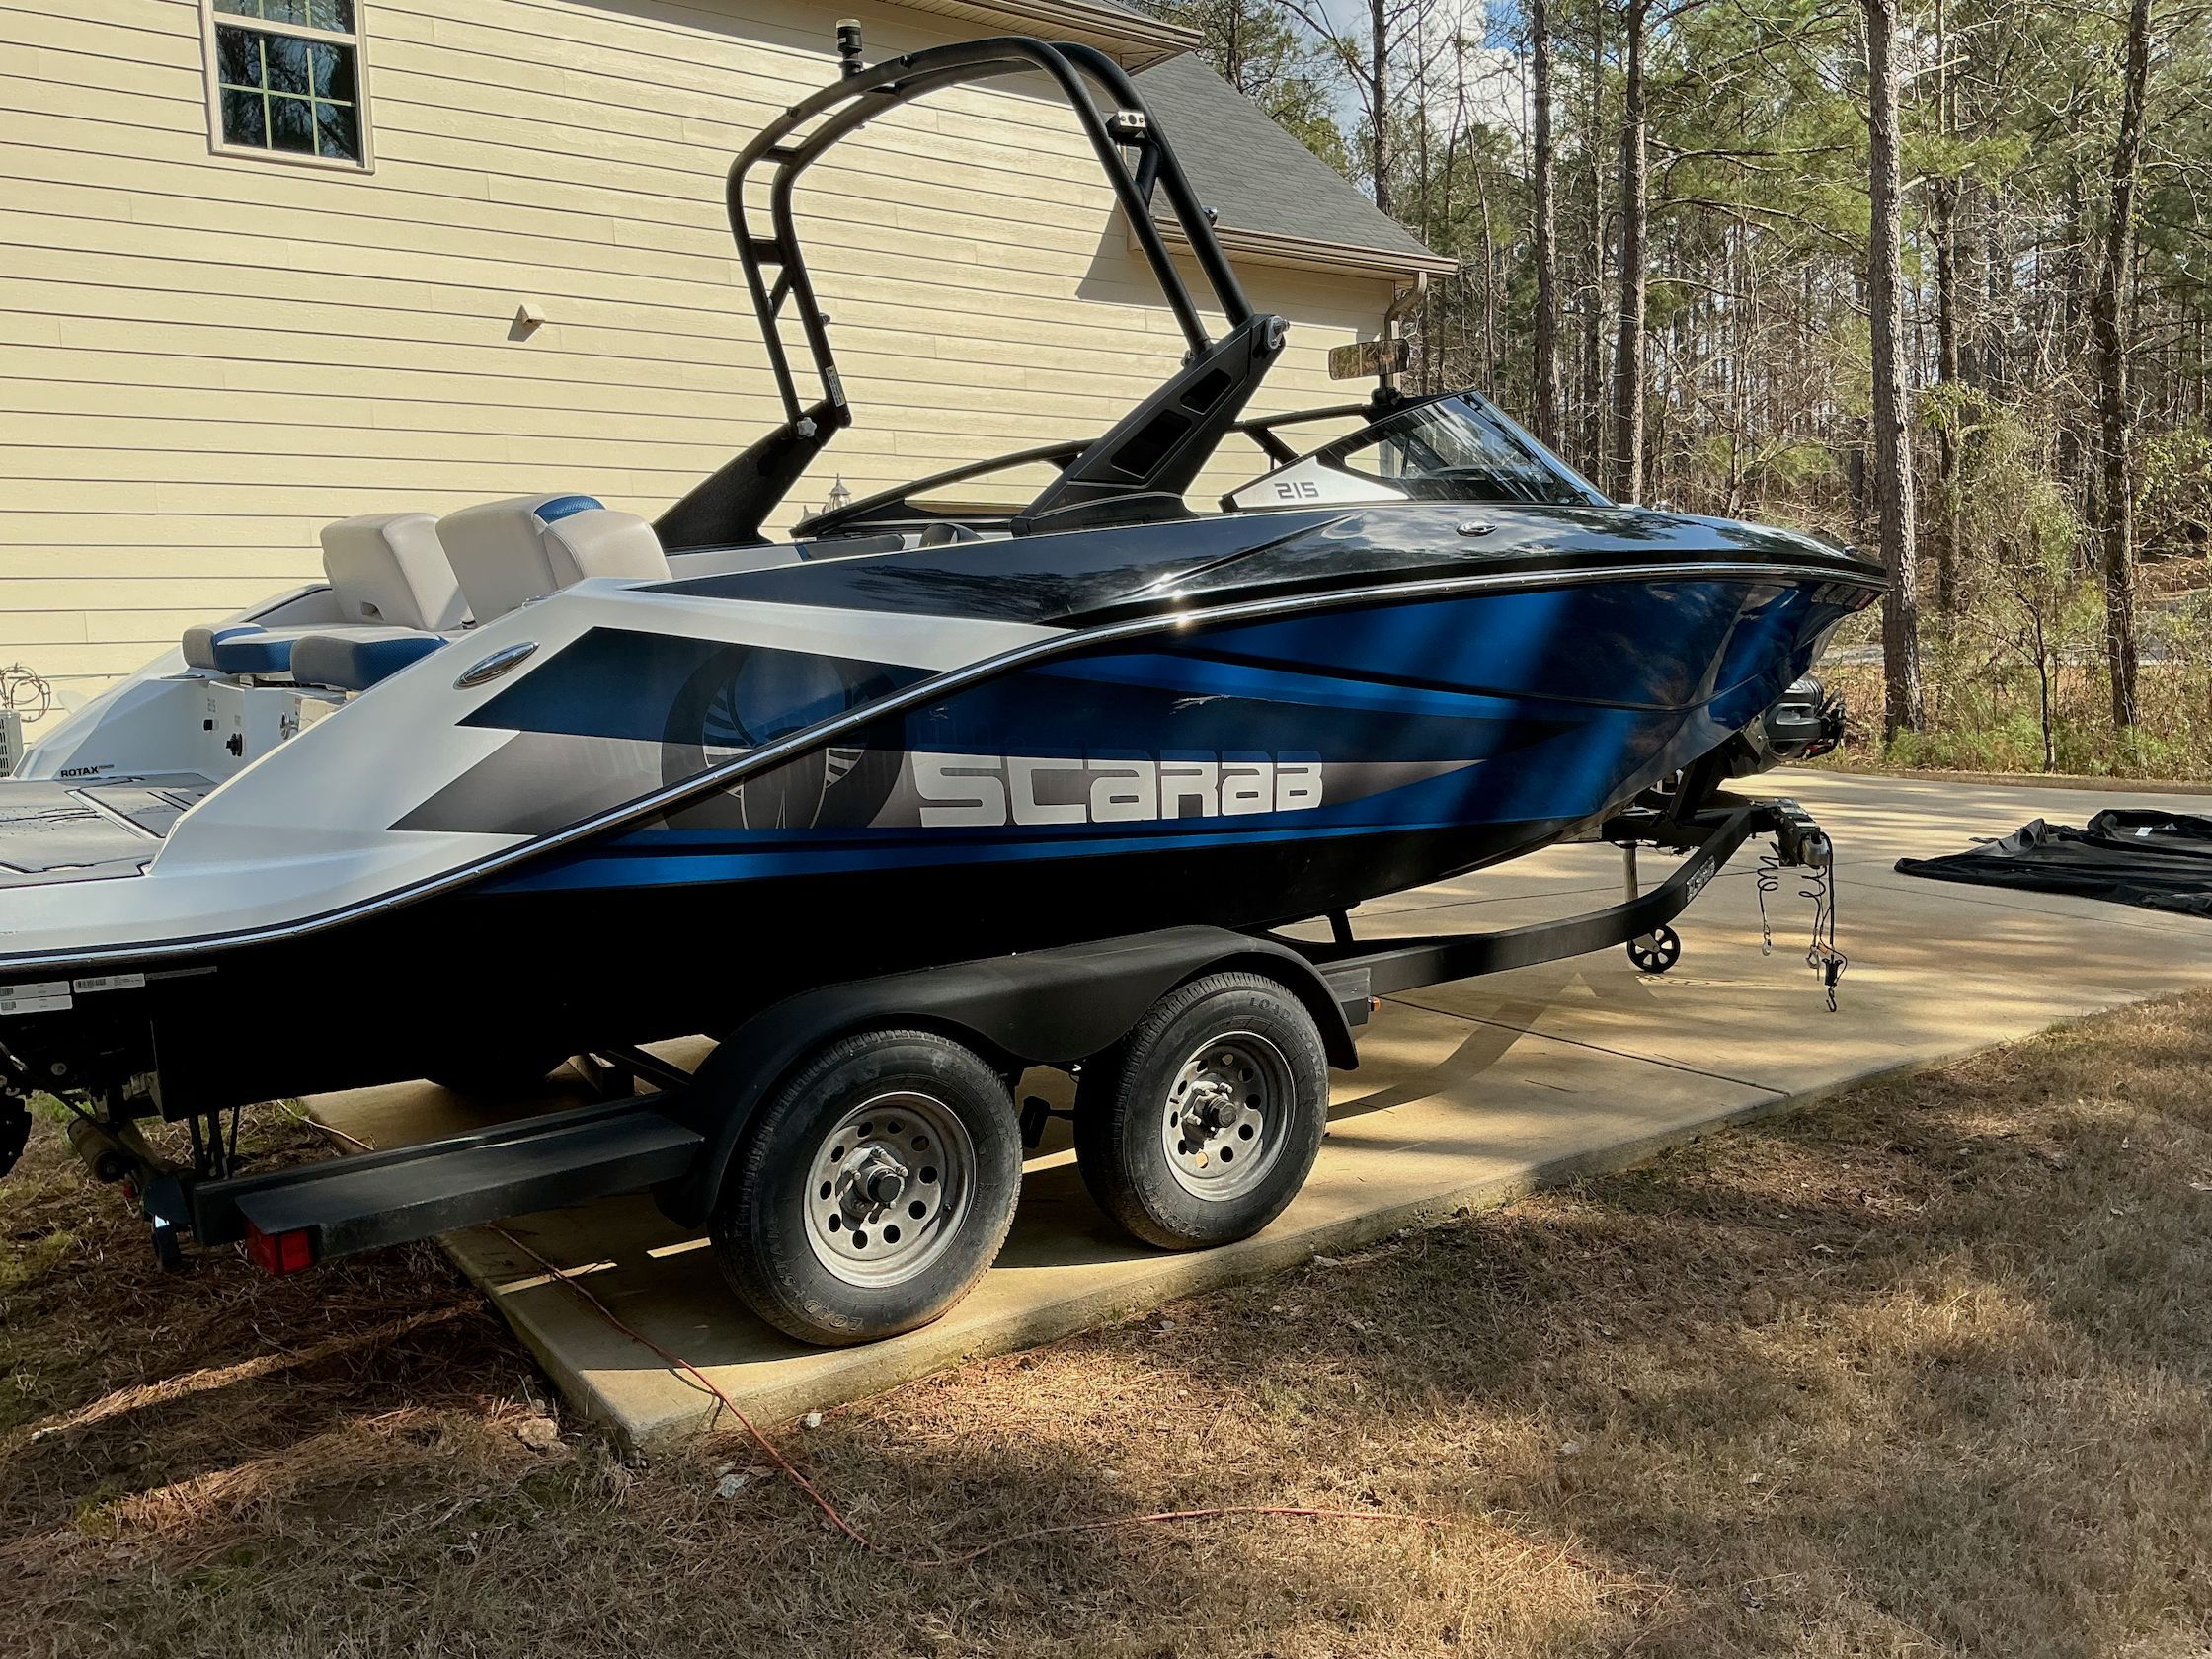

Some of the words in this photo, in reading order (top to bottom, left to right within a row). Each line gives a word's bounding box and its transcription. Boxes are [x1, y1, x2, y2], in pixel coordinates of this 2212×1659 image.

[1274, 482, 1319, 499] 215
[60, 766, 99, 777] ROTAX
[802, 1298, 864, 1331] LOAD
